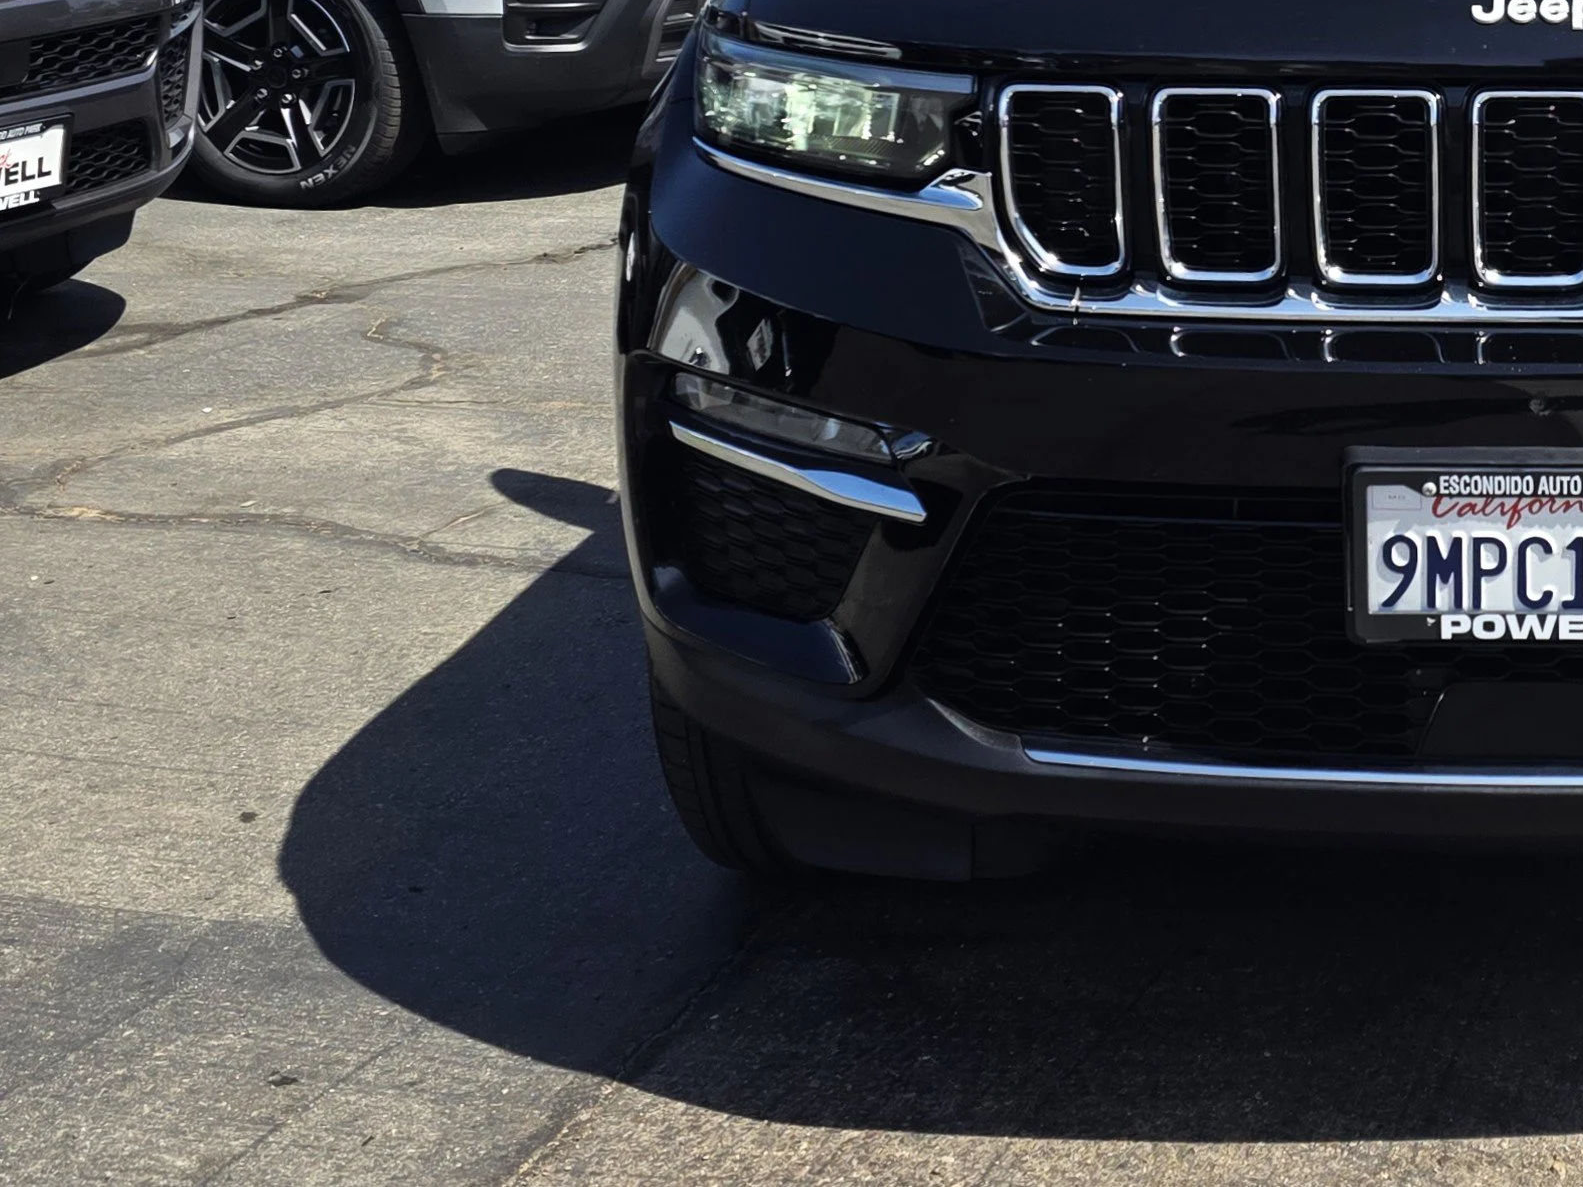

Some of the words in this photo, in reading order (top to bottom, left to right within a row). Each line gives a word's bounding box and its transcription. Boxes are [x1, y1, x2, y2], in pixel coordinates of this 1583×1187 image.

[0, 157, 52, 186] ELL
[300, 144, 356, 190] NEXEN
[1439, 475, 1535, 495] ESCONDIDO
[1537, 475, 1582, 495] AUTO
